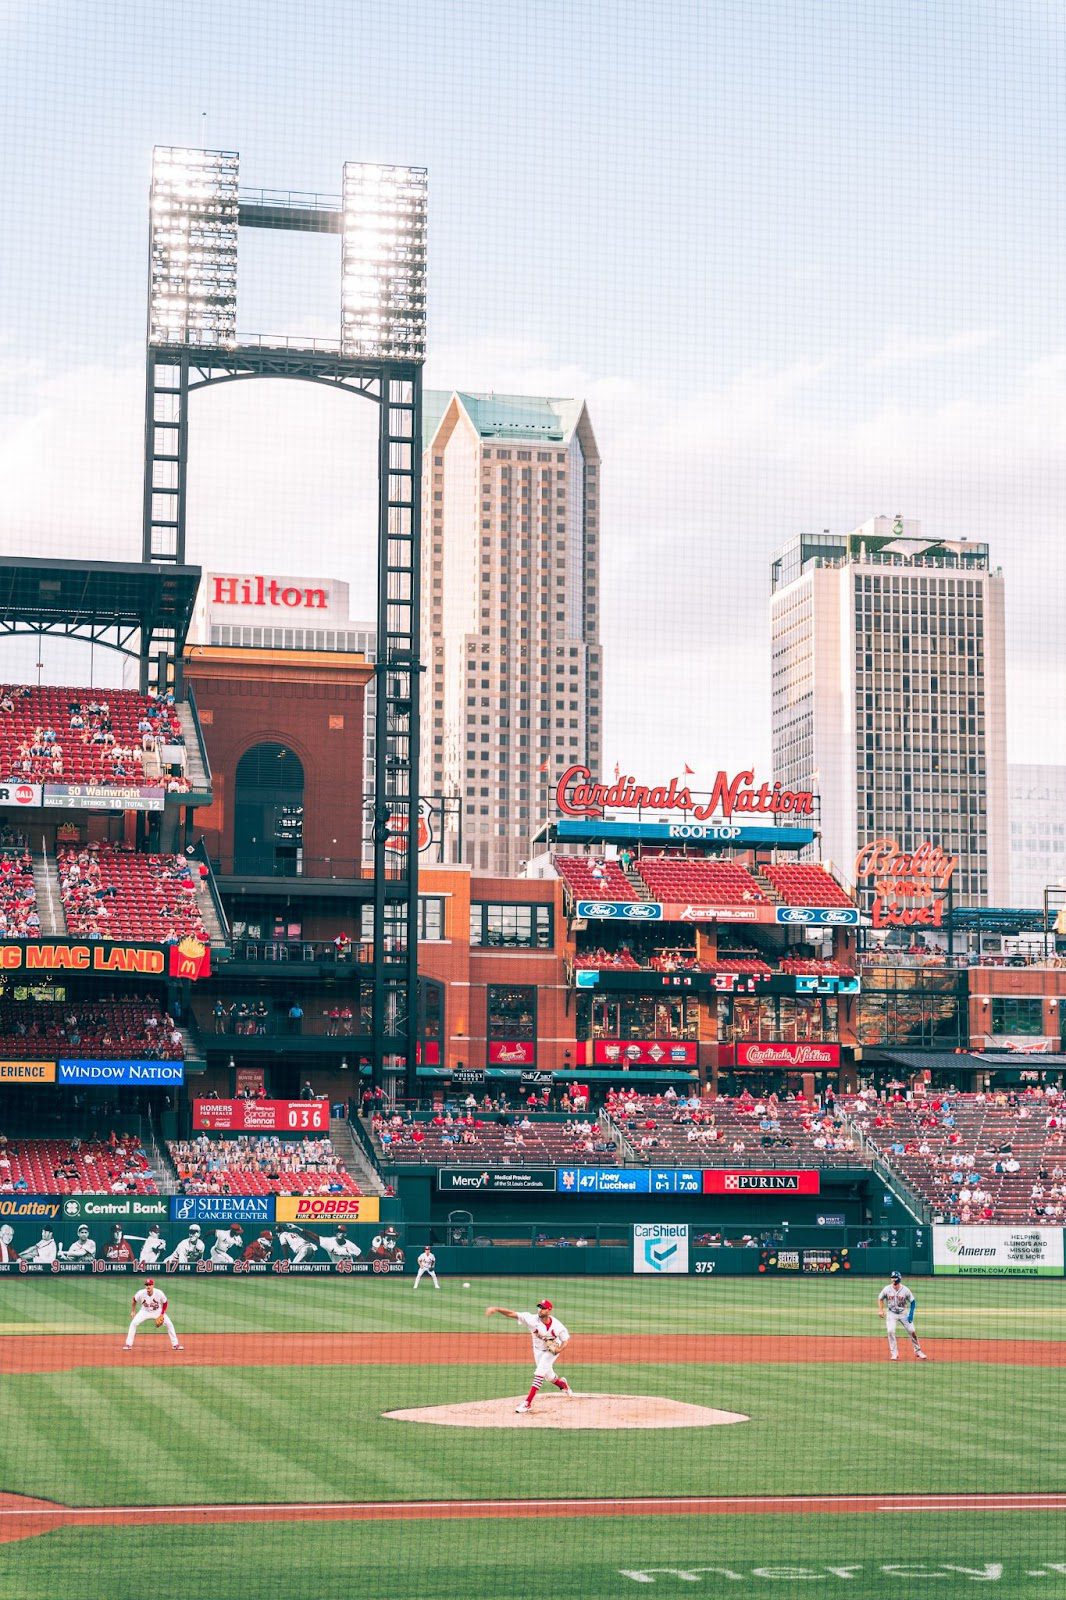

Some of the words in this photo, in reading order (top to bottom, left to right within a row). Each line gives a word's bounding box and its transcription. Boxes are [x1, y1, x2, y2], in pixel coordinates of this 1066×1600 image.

[213, 576, 327, 608] Hilton
[68, 786, 81, 796] 50
[86, 786, 141, 799] Wainwright
[556, 764, 697, 817] Cardinals
[694, 770, 814, 820] Nation
[68, 798, 75, 807] 2
[110, 800, 122, 809] 10
[148, 801, 160, 809] 12
[669, 825, 742, 839] ROOFTOP
[855, 838, 958, 889] Bally
[876, 881, 932, 897] SPORTS
[590, 904, 611, 916] Ford
[629, 905, 650, 917] Ford
[691, 907, 755, 918] cardinals.com
[788, 910, 810, 921] Ford
[826, 911, 848, 922] Ford
[872, 899, 944, 928] Live!
[26, 946, 90, 969] MAC
[94, 946, 165, 974] LAND
[746, 1046, 792, 1064] Cardinals
[791, 1046, 831, 1064] Nation
[452, 1175, 482, 1188] Mercy
[580, 1176, 595, 1187] 47
[600, 1172, 620, 1183] Joey
[740, 1177, 797, 1188] PURINA
[600, 1182, 636, 1190] Lucchesi
[656, 1182, 670, 1190] 0-1
[680, 1182, 698, 1190] 7.00
[85, 1201, 130, 1214] Central
[133, 1202, 167, 1214] Bank
[198, 1198, 268, 1211] SITEMAN
[298, 1200, 359, 1212] DOBBS
[634, 1225, 687, 1237] CarShield
[958, 1246, 996, 1256] Ameren
[19, 1260, 28, 1273] 6
[51, 1260, 60, 1273] 9
[92, 1260, 106, 1273] 10
[132, 1259, 146, 1273] 14
[166, 1260, 179, 1273] 17
[196, 1260, 214, 1273] 20
[233, 1260, 250, 1273] 24
[272, 1260, 290, 1273] 42
[336, 1260, 352, 1273] 45
[372, 1259, 390, 1273] 85
[695, 1262, 716, 1273] 375'
